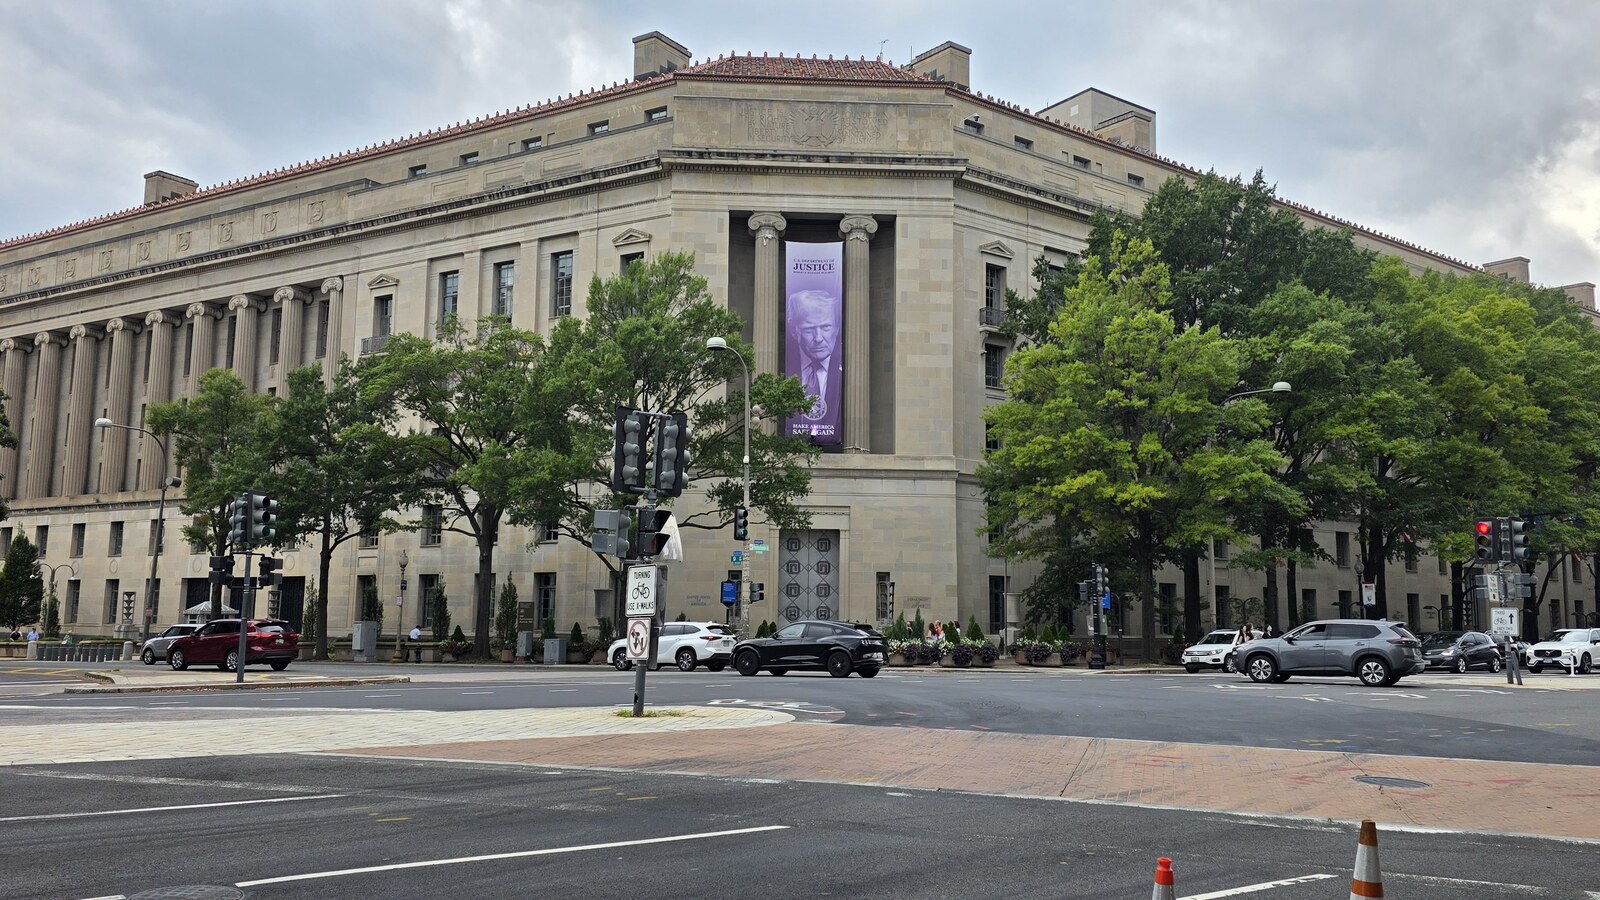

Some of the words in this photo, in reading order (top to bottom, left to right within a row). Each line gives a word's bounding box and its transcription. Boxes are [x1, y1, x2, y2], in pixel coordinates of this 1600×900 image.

[793, 263, 835, 271] JUSTICE
[634, 571, 651, 579] TURNING
[627, 603, 635, 611] USE
[636, 602, 654, 610] X-WALKS
